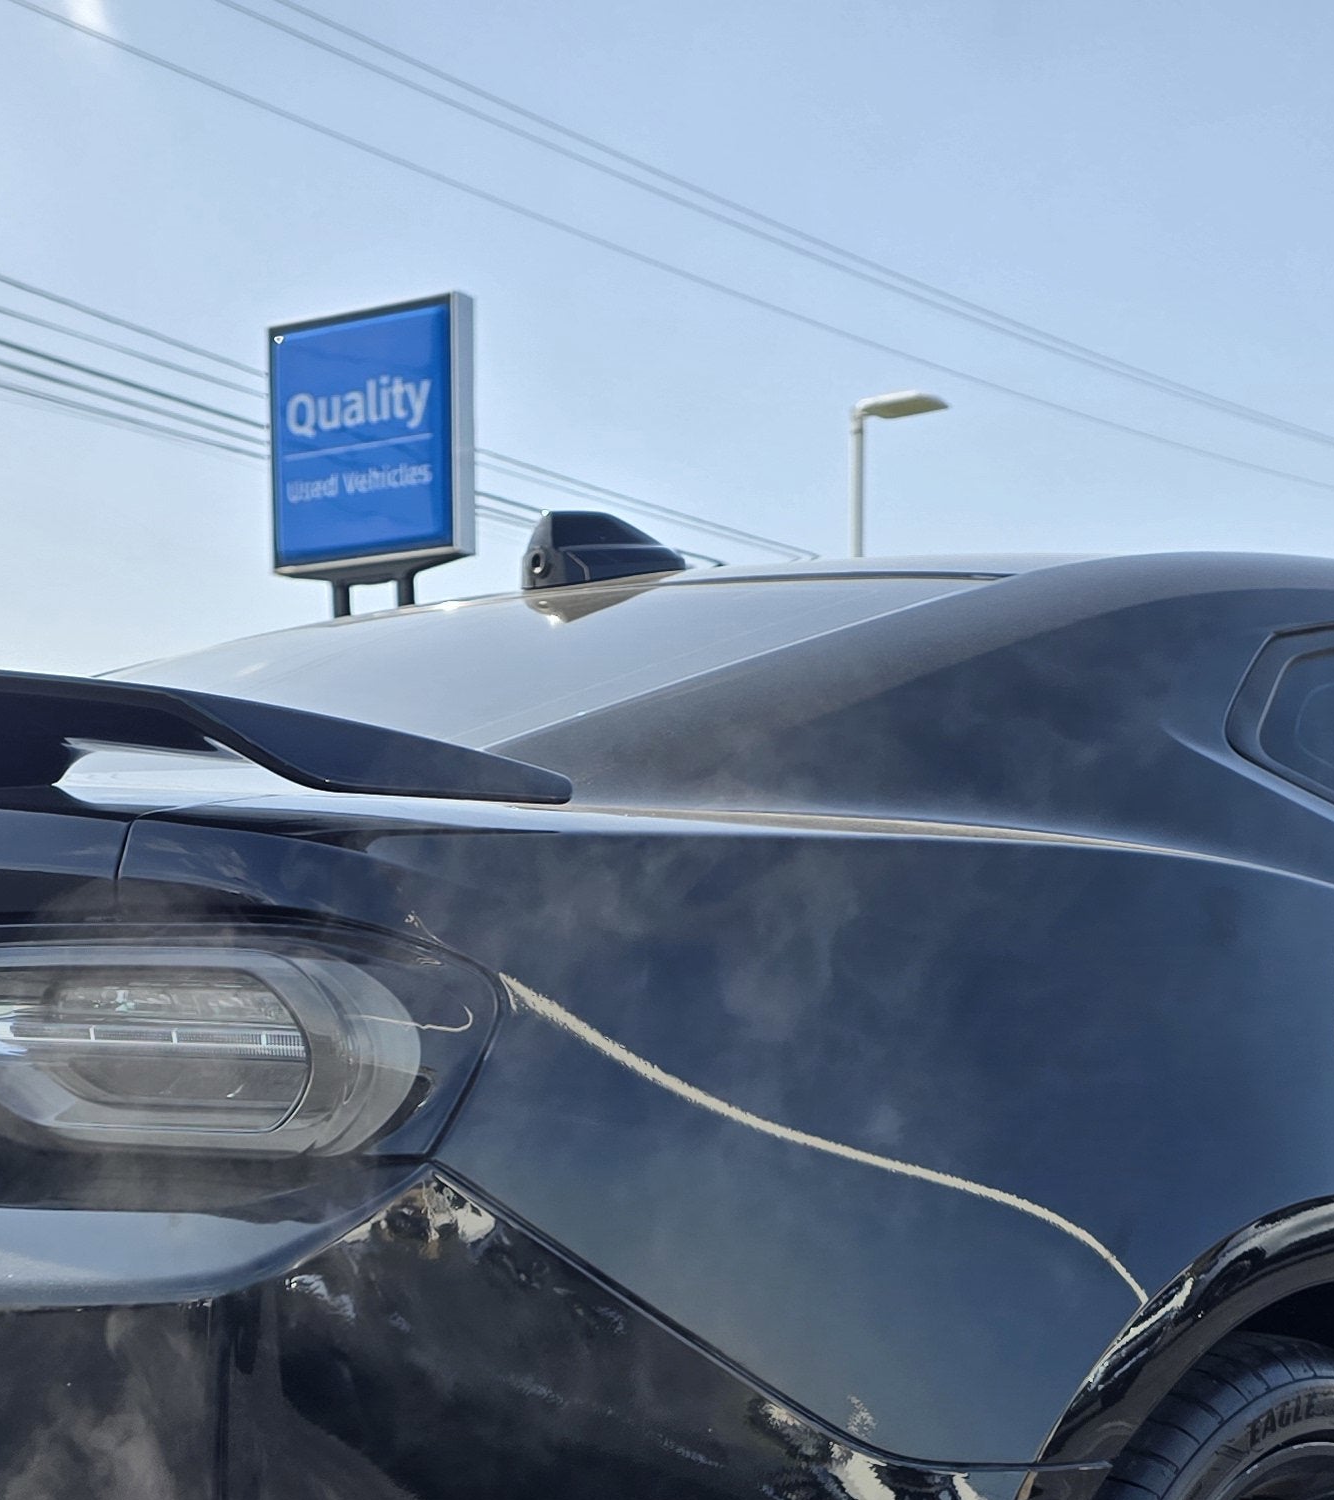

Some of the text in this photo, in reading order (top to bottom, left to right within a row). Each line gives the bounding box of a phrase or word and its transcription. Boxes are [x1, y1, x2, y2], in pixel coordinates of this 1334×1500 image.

[287, 375, 431, 437] Quality
[287, 463, 432, 503] Used Vehicles
[1246, 1390, 1318, 1449] EAGLE
